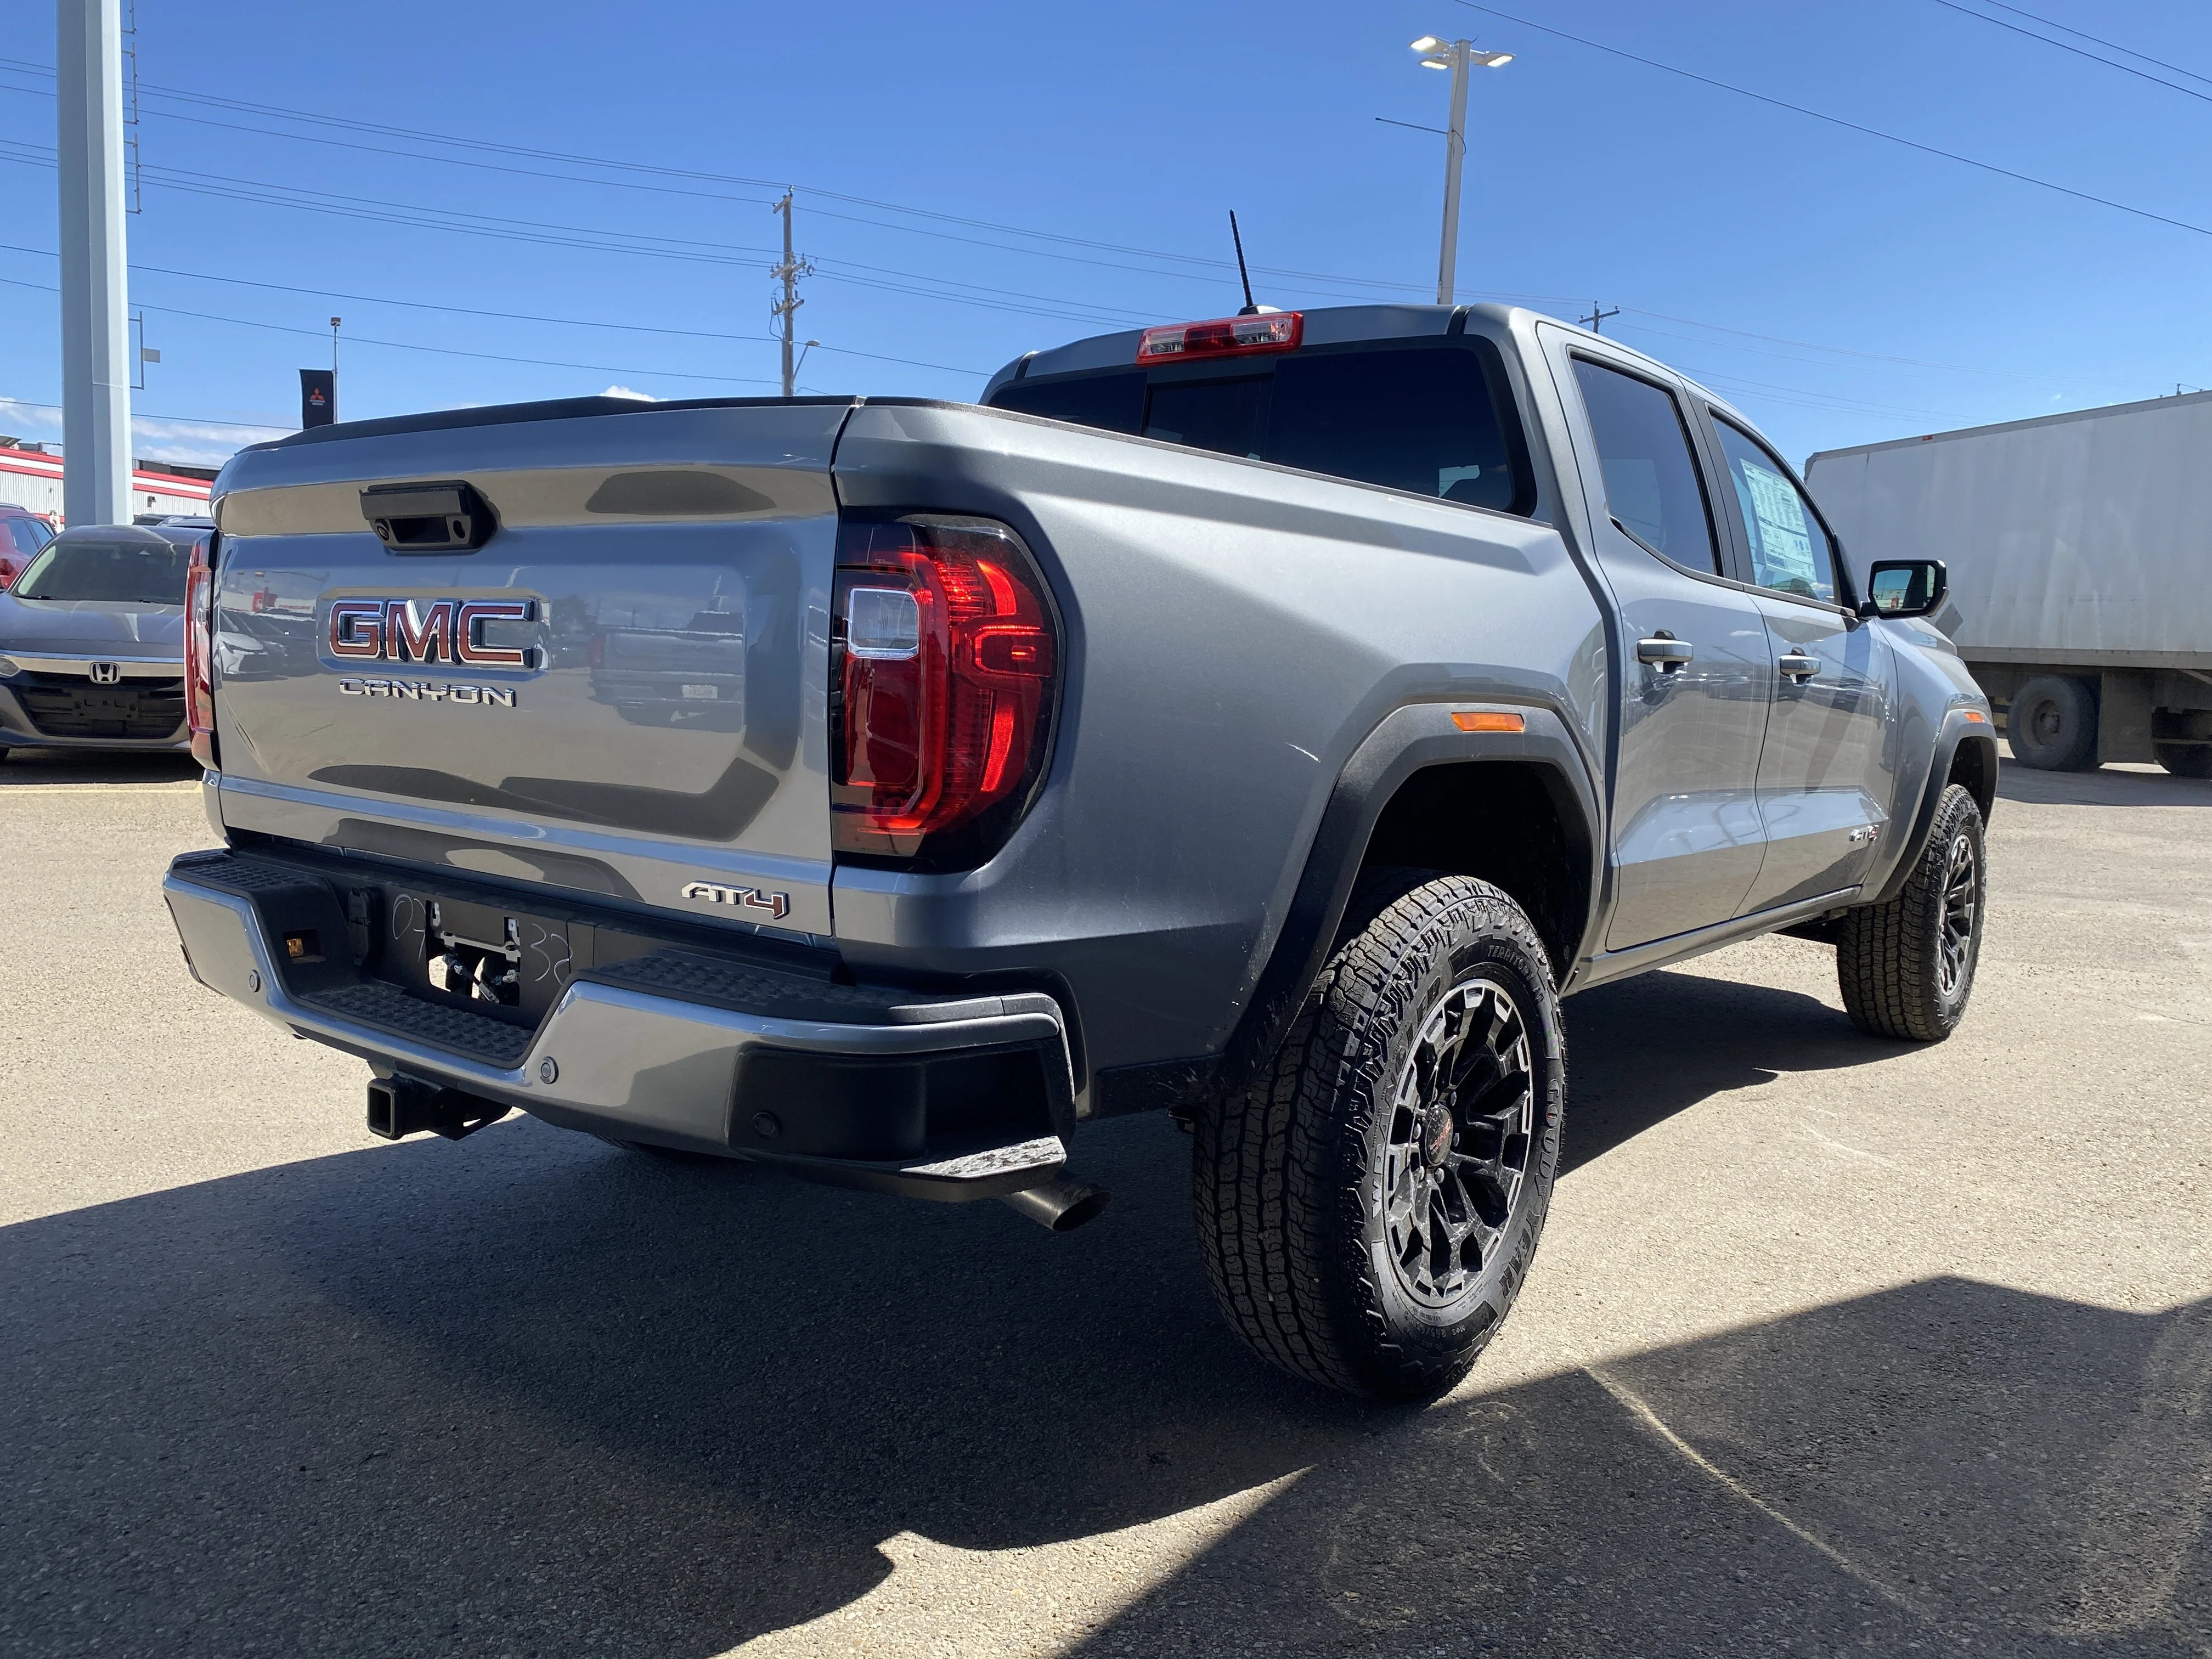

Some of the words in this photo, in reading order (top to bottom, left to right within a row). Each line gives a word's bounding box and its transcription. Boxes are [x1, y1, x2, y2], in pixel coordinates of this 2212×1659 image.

[330, 597, 532, 668] GMC
[339, 678, 516, 707] CANYON
[681, 881, 790, 919] AT4
[1487, 945, 1534, 981] TERRITORY
